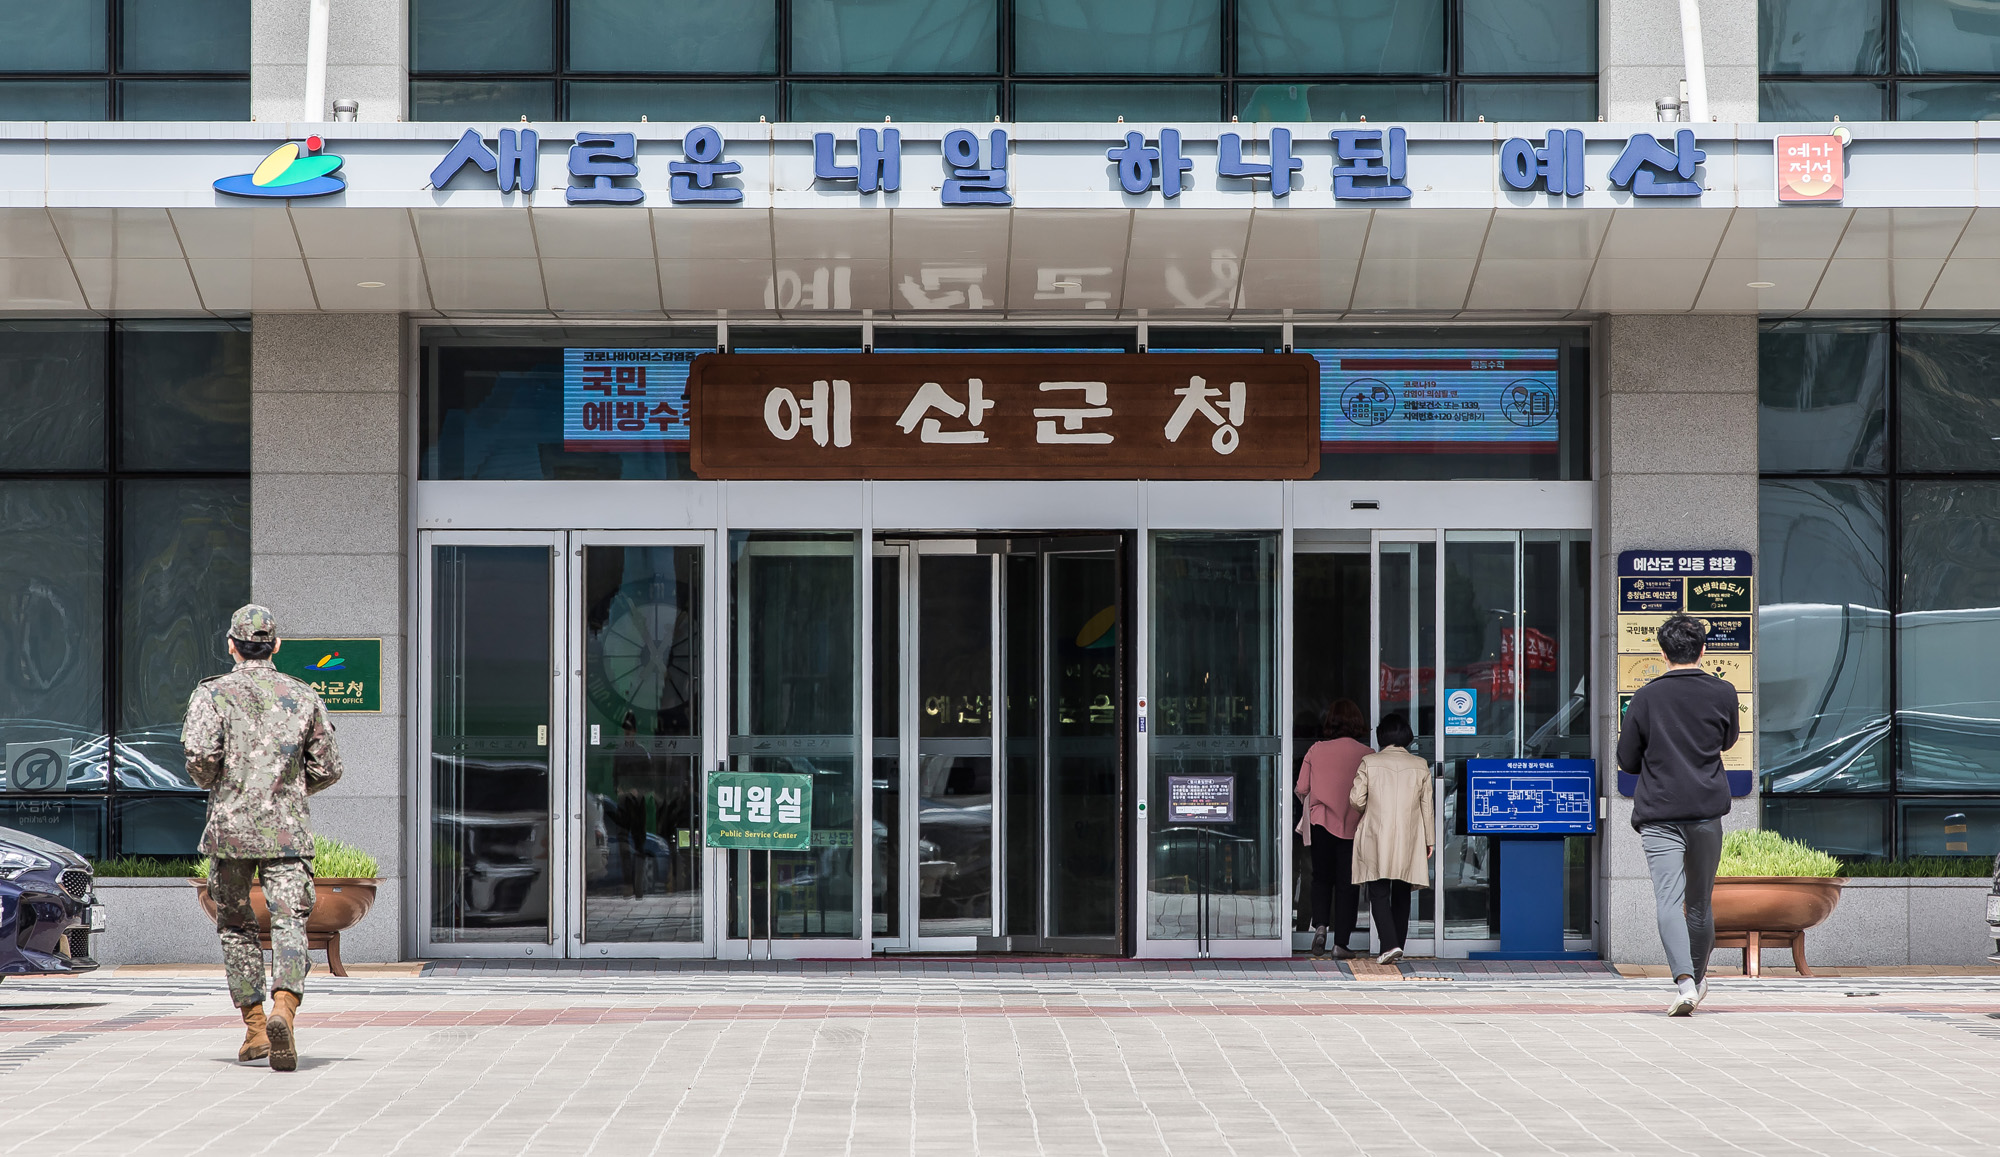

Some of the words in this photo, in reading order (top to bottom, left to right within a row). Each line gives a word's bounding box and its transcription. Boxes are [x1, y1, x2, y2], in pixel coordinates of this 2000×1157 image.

[1787, 142, 1834, 158] 예가
[431, 127, 743, 202] 새로운
[814, 127, 1013, 205] 내일
[1107, 127, 1412, 199] 하나된
[1500, 128, 1708, 197] 예산
[1788, 159, 1832, 183] 정성
[582, 366, 646, 396] 국민
[764, 376, 1246, 455] 예산군청
[1633, 557, 1674, 572] 예산군
[1678, 557, 1705, 571] 인증
[1709, 556, 1737, 571] 현황
[1693, 581, 1745, 596] 평생학습도시
[717, 786, 802, 824] 민원실
[720, 830, 742, 838] Public
[744, 830, 771, 839] Service
[773, 831, 798, 839] Center
